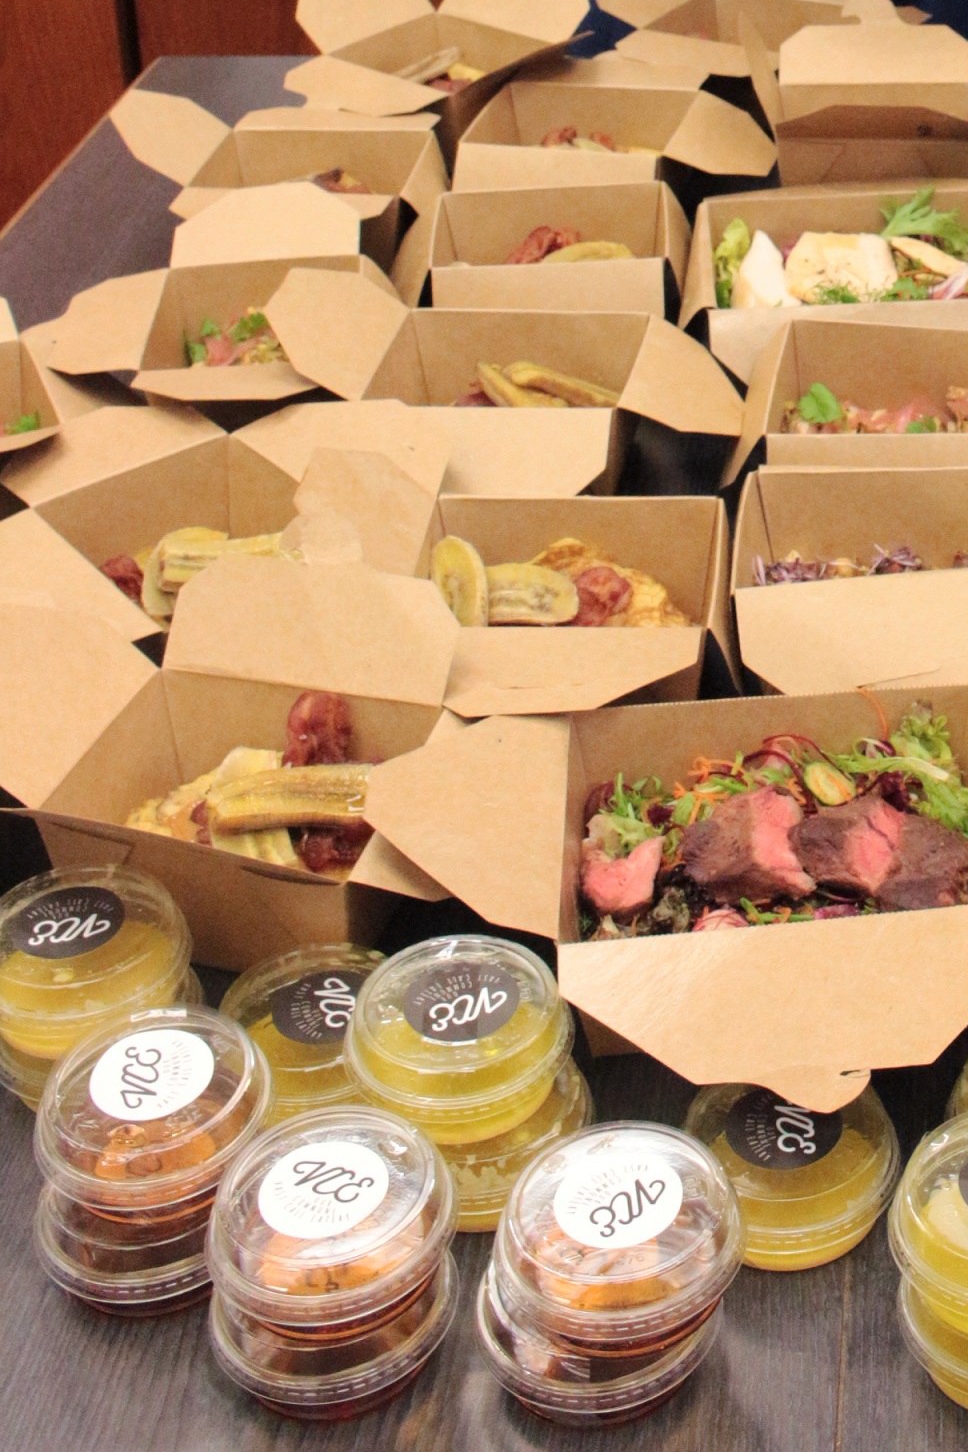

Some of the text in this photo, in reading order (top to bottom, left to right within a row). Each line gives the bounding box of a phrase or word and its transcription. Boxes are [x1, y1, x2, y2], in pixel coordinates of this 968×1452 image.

[28, 913, 111, 946] VCE
[314, 978, 356, 1027] VCE
[429, 987, 508, 1032] VCE
[120, 1046, 162, 1109] VCE
[293, 1161, 375, 1203] VCE
[589, 1178, 666, 1238] VCE
